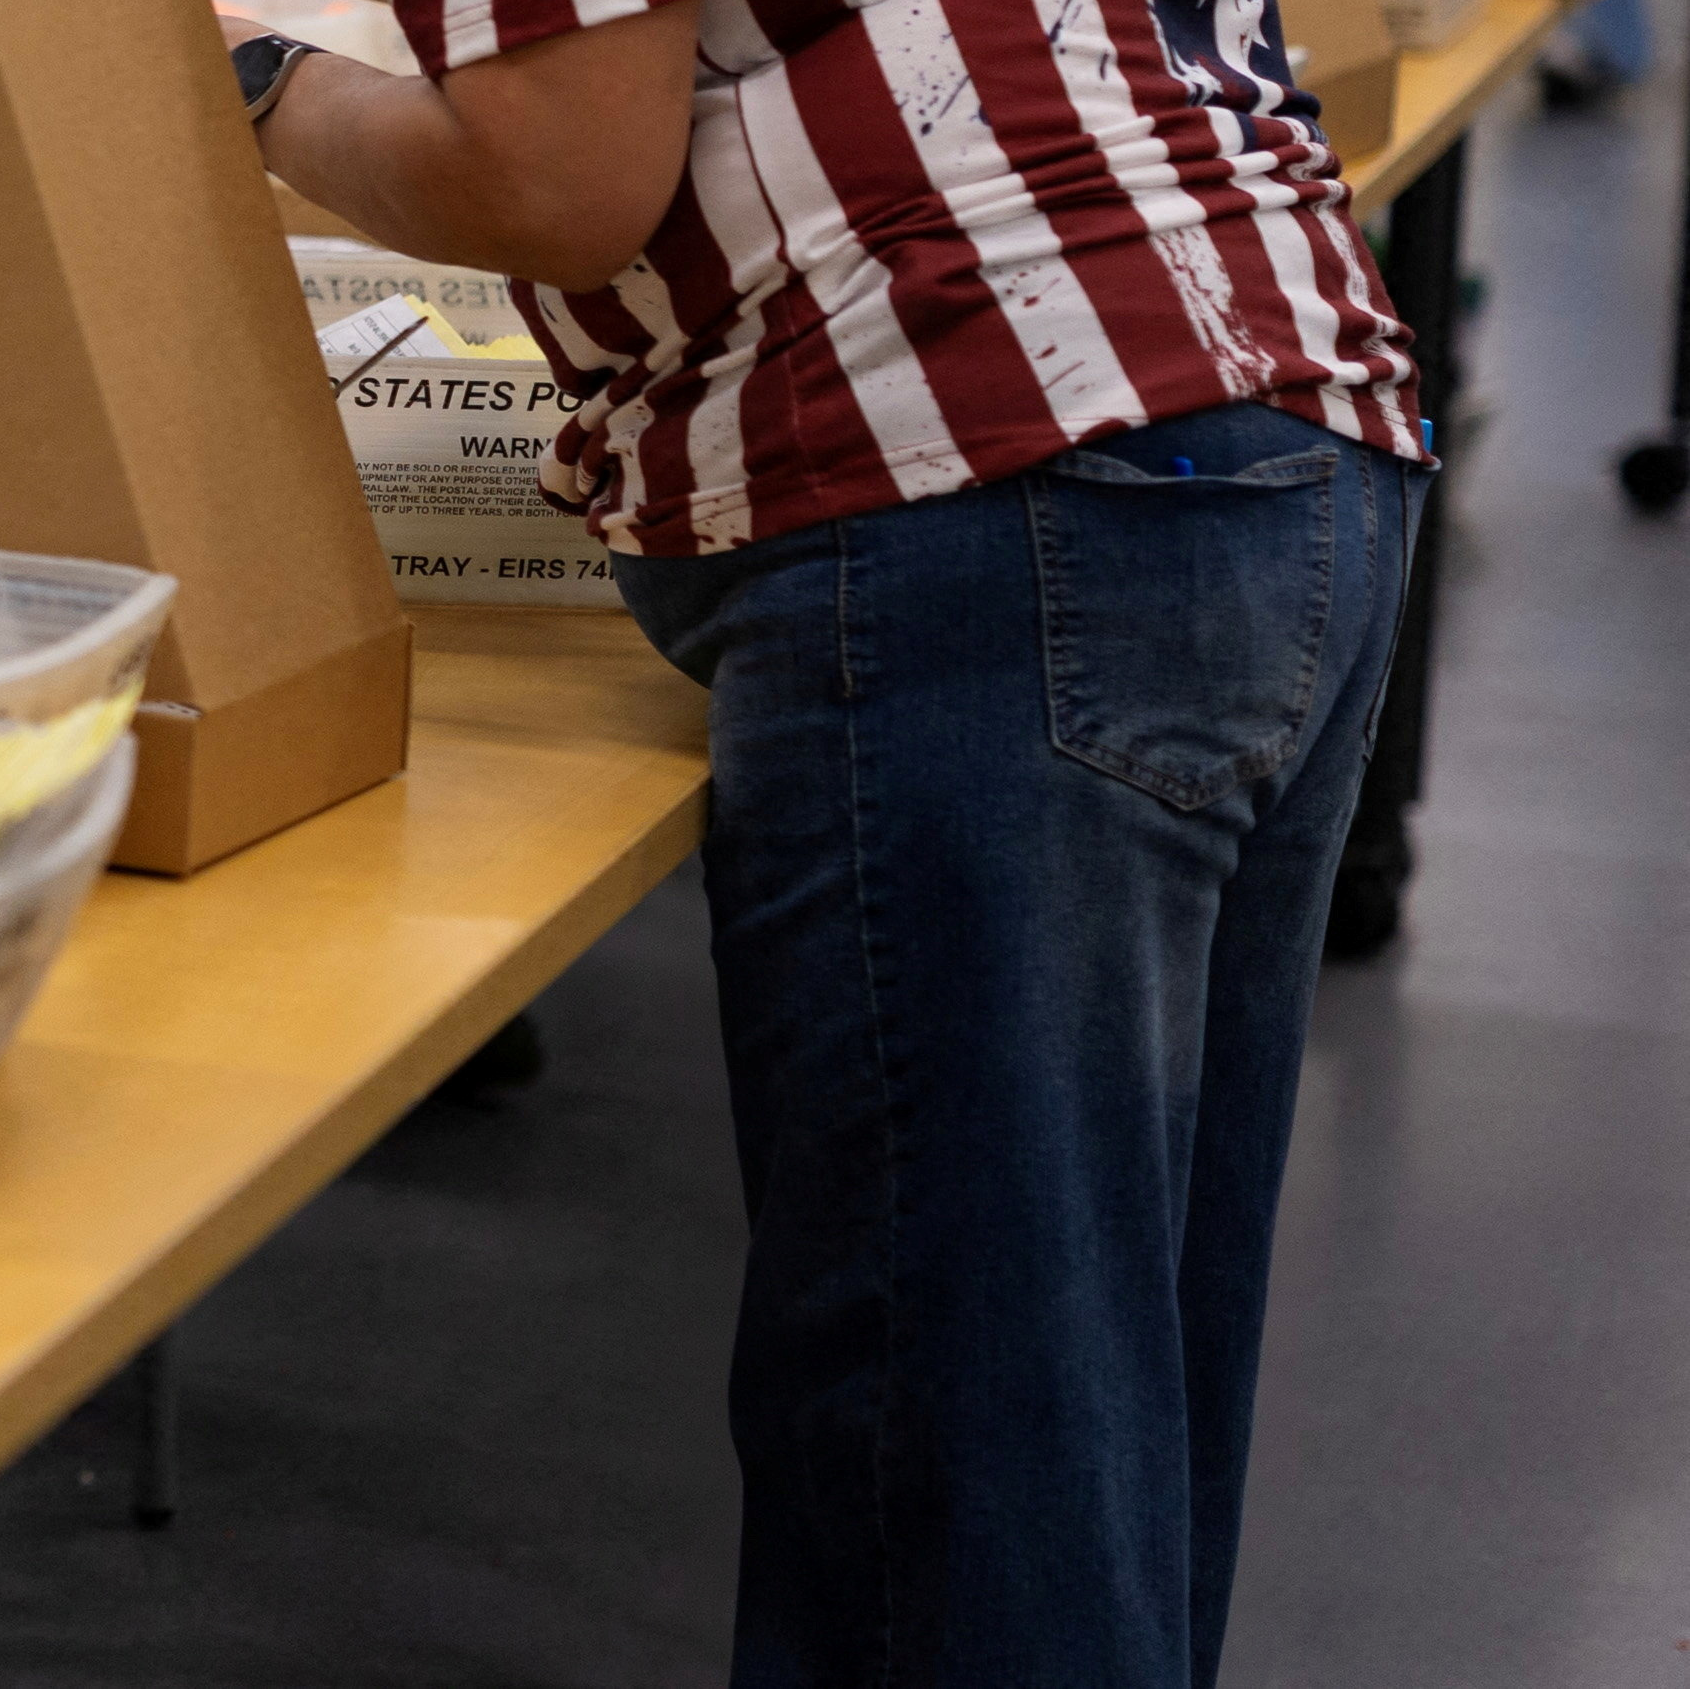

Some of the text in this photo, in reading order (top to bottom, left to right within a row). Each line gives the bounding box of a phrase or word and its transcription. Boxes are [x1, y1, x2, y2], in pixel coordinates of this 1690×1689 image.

[354, 377, 516, 412] STATES
[372, 463, 393, 471] NOT
[396, 463, 410, 472] BE
[412, 464, 440, 473] SOLD
[443, 465, 458, 473] OR
[461, 465, 516, 475] RECYCLED
[406, 474, 427, 483] FOR
[429, 475, 450, 484] ANY
[453, 476, 502, 485] PURPOSE
[417, 485, 437, 494] THE
[440, 486, 479, 495] POSTAL
[482, 487, 527, 496] SERVICE
[400, 495, 420, 504] THE
[423, 495, 475, 505] LOCATION
[477, 497, 491, 505] OF
[495, 497, 524, 506] THEIR
[381, 504, 396, 514] OF
[398, 505, 413, 514] UP
[415, 506, 430, 515] TO
[432, 507, 465, 516] THREE
[508, 509, 523, 517] OR
[525, 509, 553, 518] BOTH
[391, 555, 471, 577] TRAY
[498, 558, 565, 580] EIRS
